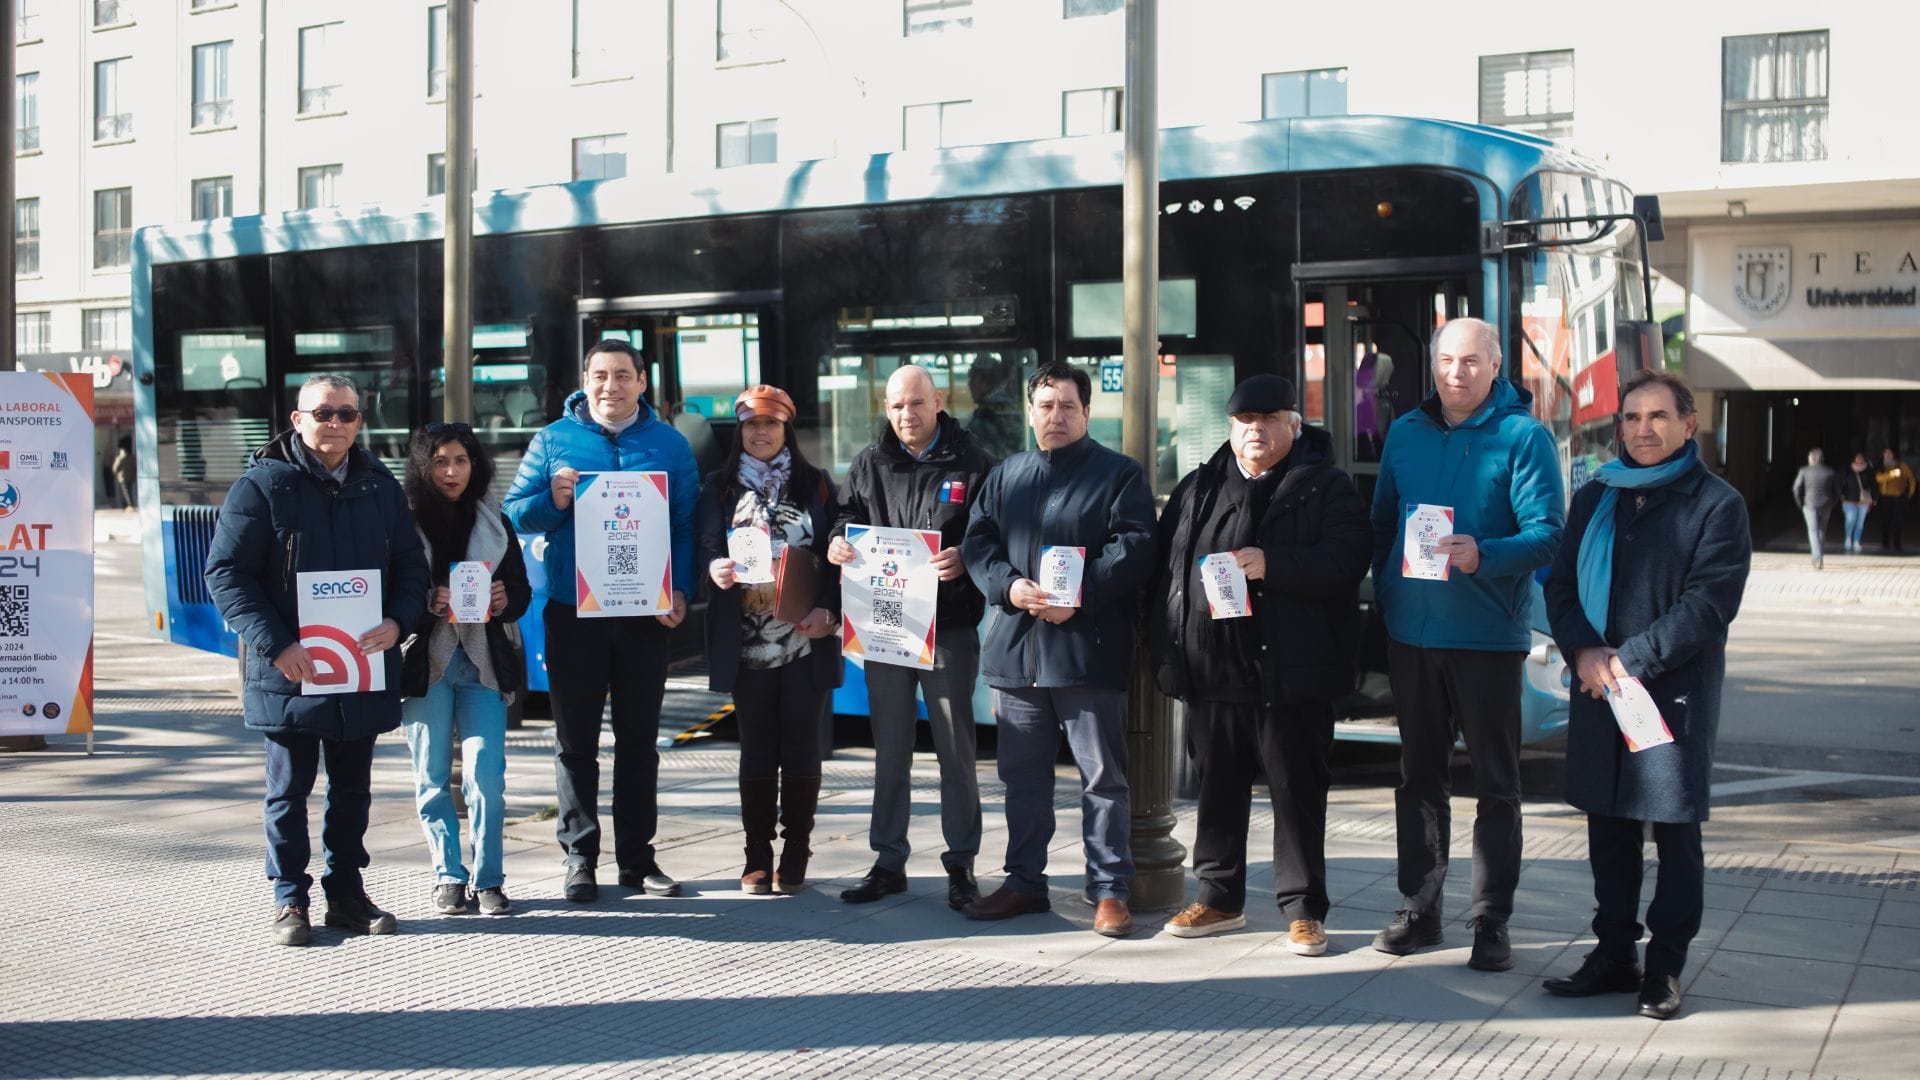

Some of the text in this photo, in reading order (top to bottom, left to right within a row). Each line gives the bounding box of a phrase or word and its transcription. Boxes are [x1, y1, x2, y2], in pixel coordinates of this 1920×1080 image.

[1806, 286, 1916, 308] Universidad
[1103, 367, 1124, 391] 55
[6, 402, 61, 412] LABORAL
[604, 520, 641, 531] FELAT
[608, 532, 638, 541] 2024
[0, 556, 40, 578] 24
[312, 576, 369, 596] sence
[870, 575, 909, 589] FELAT
[874, 587, 904, 598] 2024
[4, 643, 24, 652] 2024
[0, 653, 32, 662] ernación
[9, 676, 32, 685] 14:00
[32, 676, 45, 685] hrs
